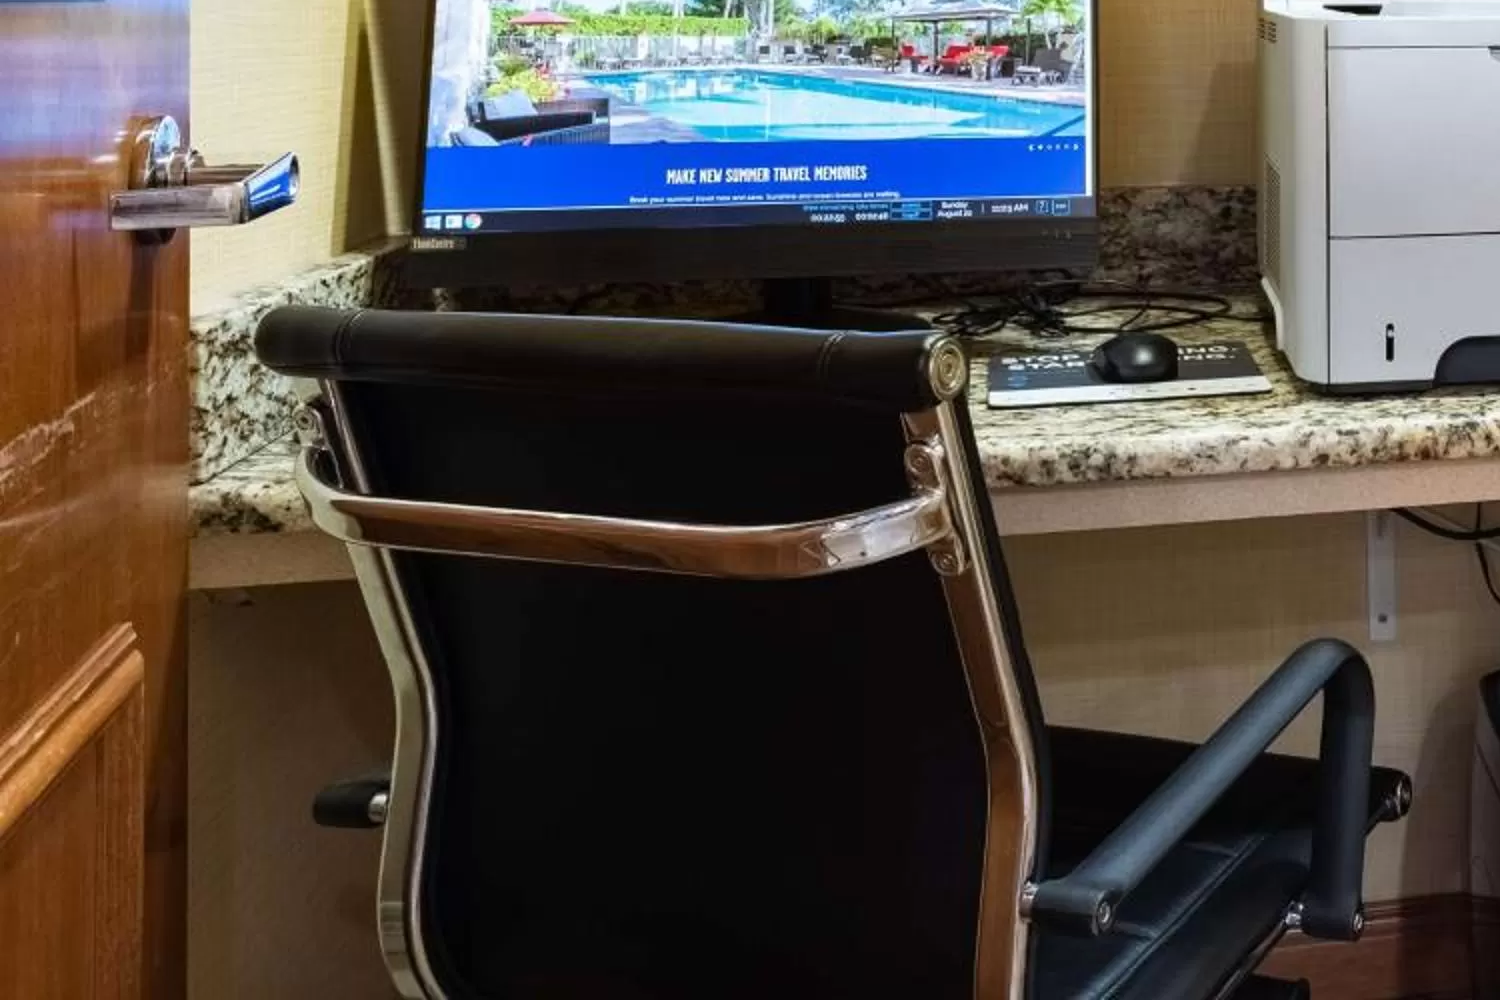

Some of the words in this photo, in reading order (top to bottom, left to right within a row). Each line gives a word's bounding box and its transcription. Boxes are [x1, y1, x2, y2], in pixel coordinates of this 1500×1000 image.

[666, 168, 696, 184] MAKE
[699, 168, 722, 183] NEW
[725, 167, 770, 183] SUMMER
[773, 166, 810, 182] TRAVEL
[814, 165, 867, 181] MEMORIES
